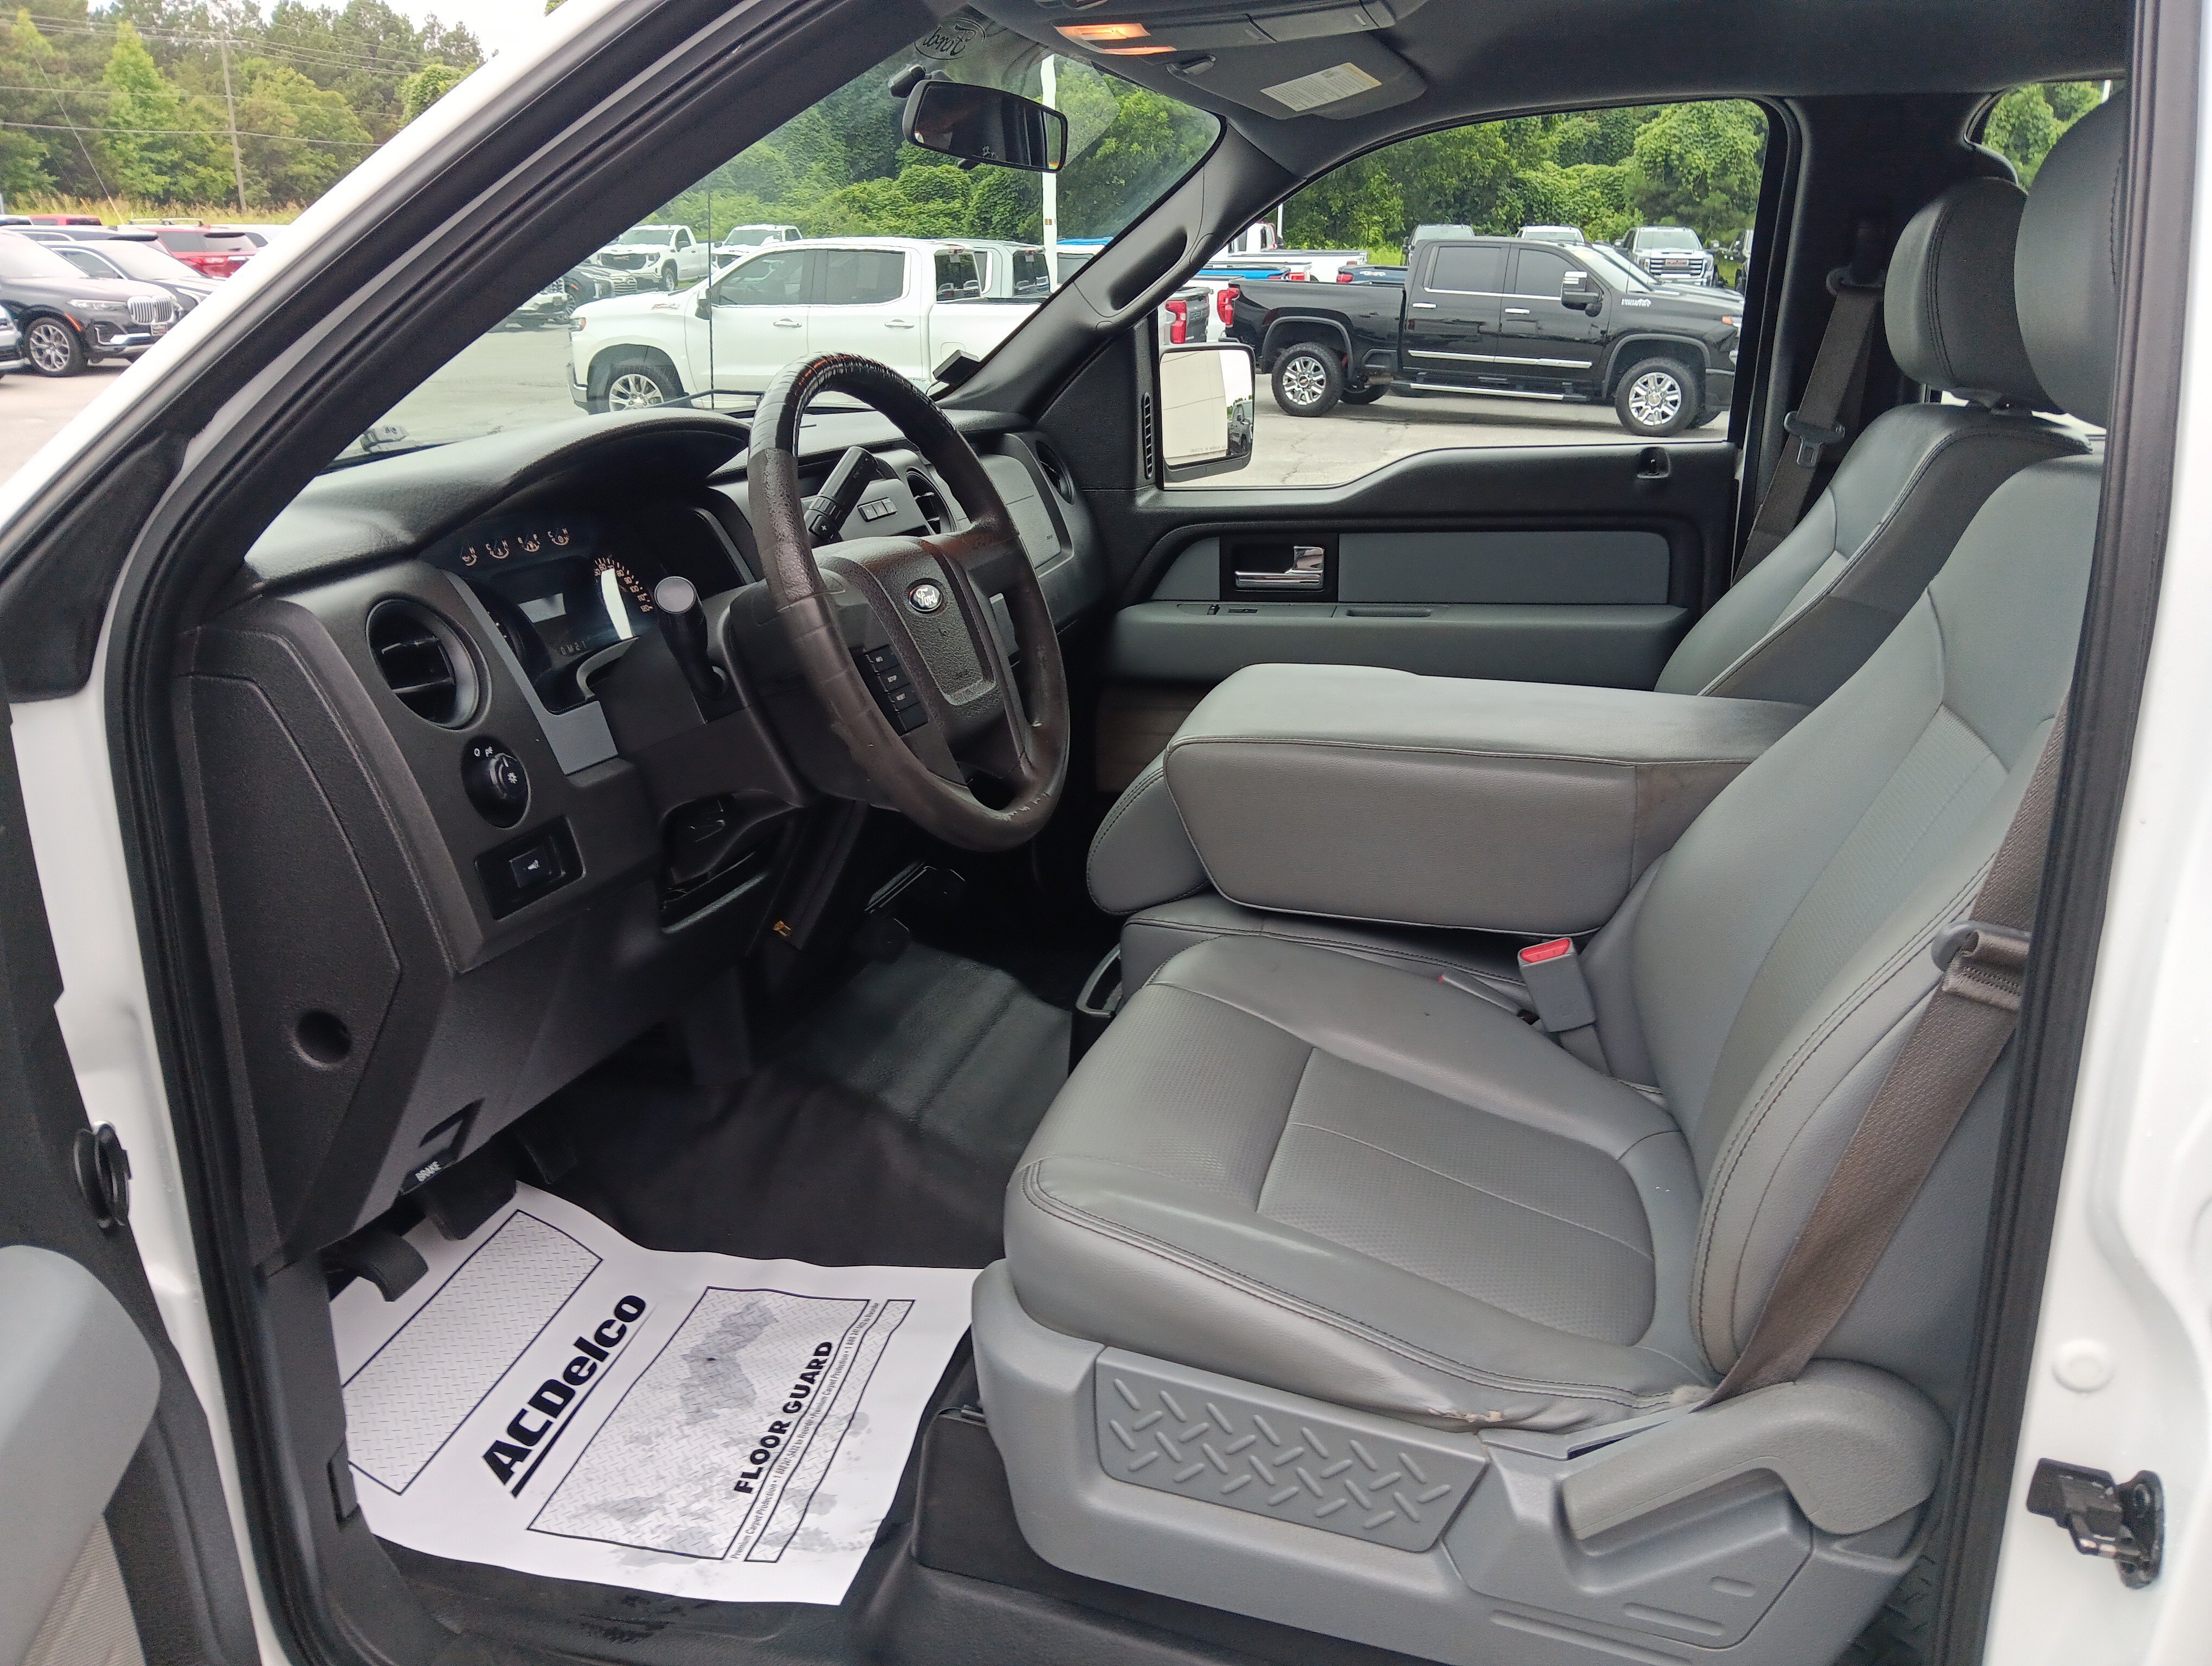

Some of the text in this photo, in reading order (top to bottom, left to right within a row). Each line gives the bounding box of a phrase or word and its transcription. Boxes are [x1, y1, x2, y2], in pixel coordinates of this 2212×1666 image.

[616, 569, 625, 577] 80
[623, 576, 633, 584] 90
[916, 587, 938, 607] Ford
[829, 1354, 849, 1379] Protection
[482, 1295, 646, 1485] ACDelco
[821, 1379, 838, 1395] Carpet
[734, 1341, 833, 1494] FLOOR GUARD
[809, 1395, 828, 1417] Premium
[755, 1484, 778, 1515] Protection
[744, 1515, 763, 1534] Carpet
[729, 1535, 752, 1559] Premium
